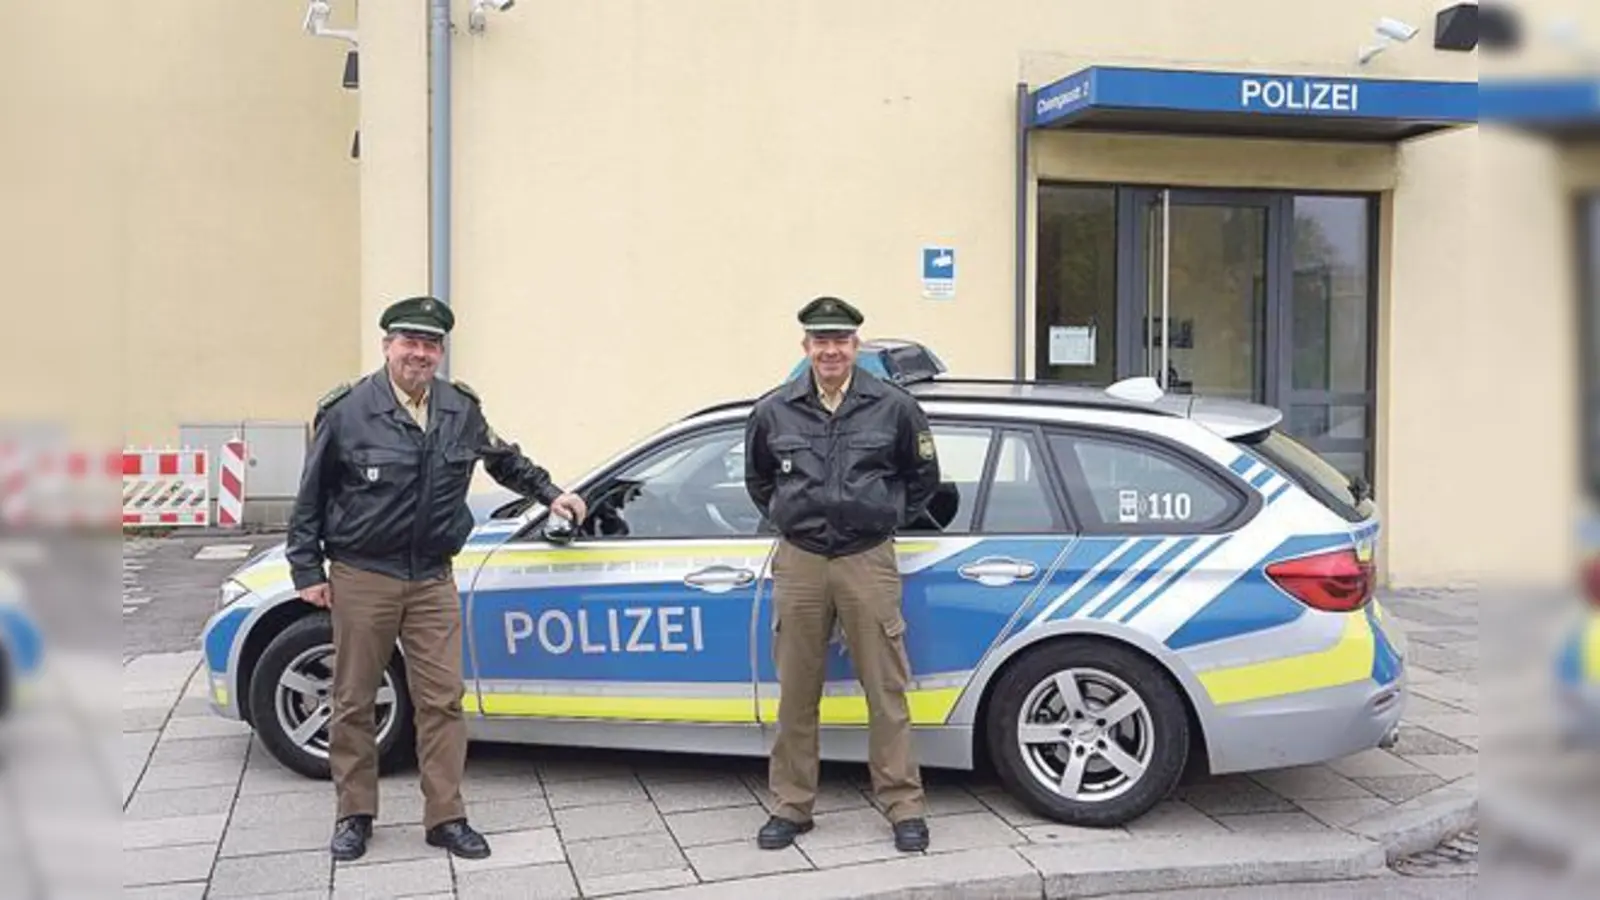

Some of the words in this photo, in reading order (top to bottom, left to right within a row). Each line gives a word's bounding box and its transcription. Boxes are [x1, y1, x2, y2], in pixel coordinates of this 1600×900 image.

[1241, 79, 1359, 111] POLIZEI
[1148, 492, 1192, 520] 110
[504, 605, 704, 655] POLIZEI
